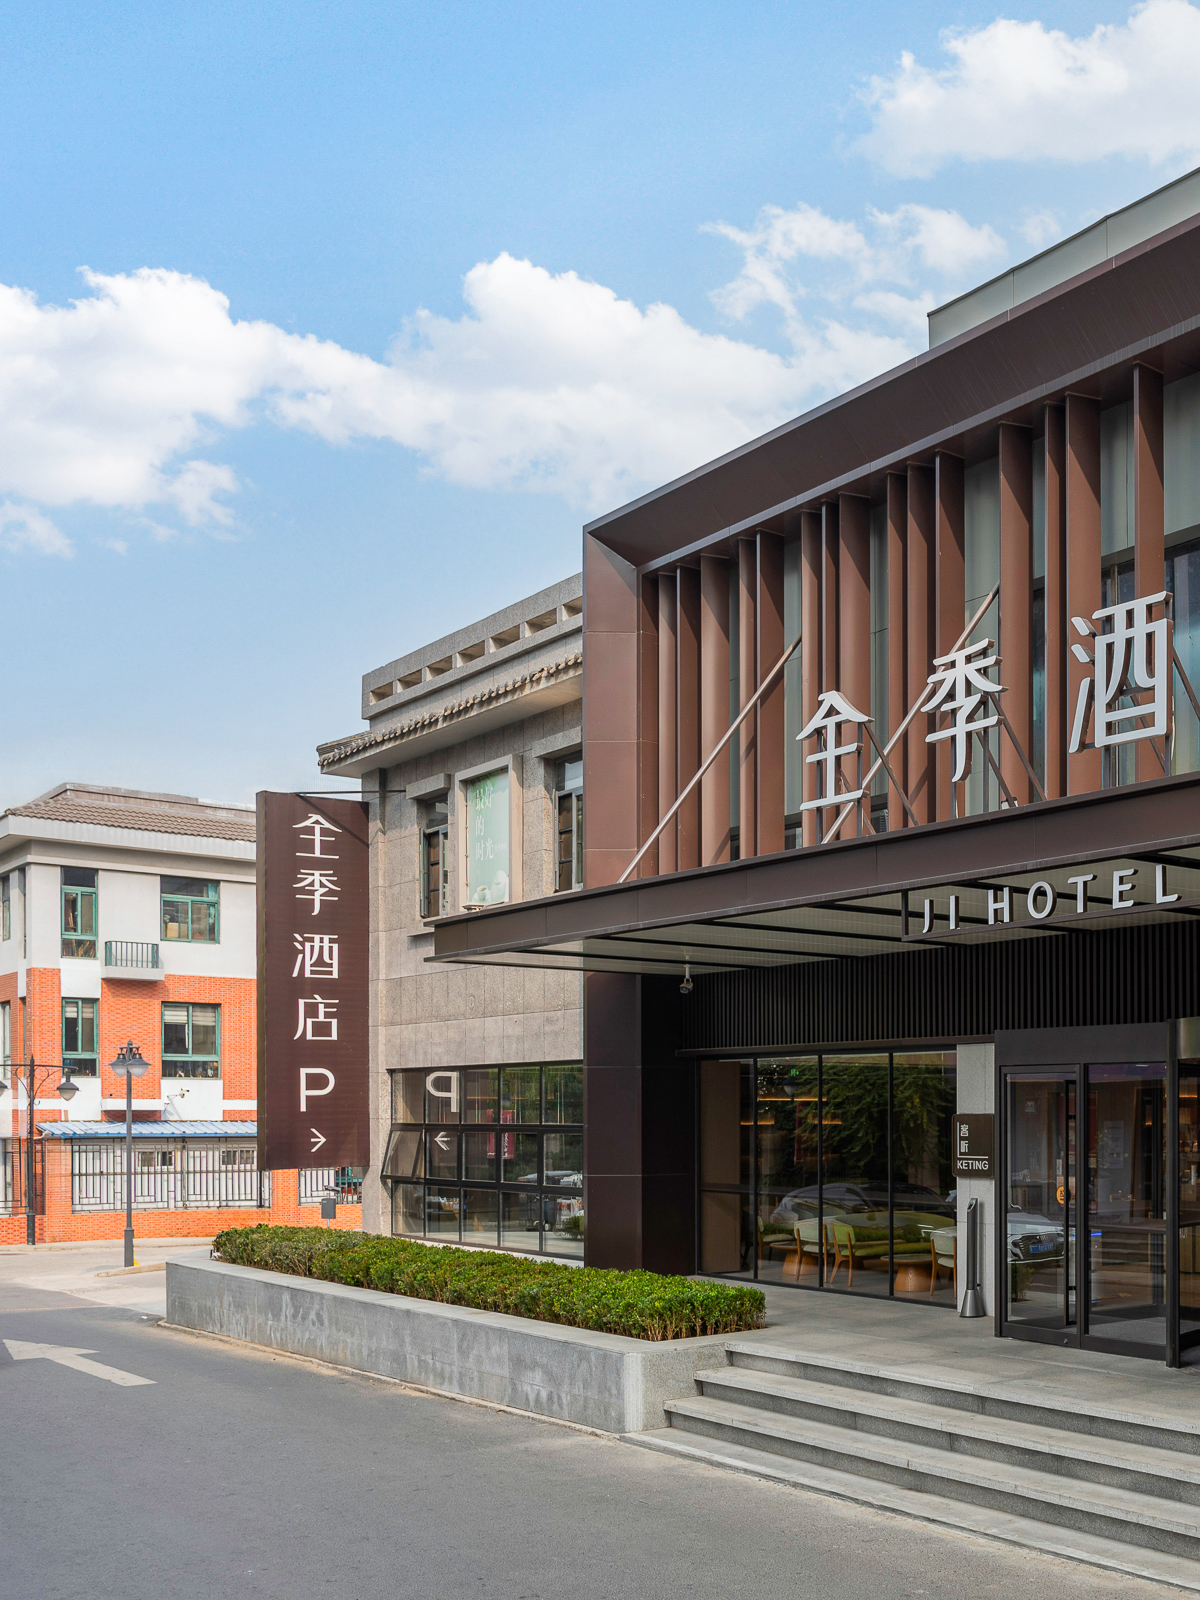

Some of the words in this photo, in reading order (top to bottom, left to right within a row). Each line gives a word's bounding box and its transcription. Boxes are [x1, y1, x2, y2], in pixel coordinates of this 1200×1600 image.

[475, 786, 494, 809] 最好
[475, 815, 485, 836] 的
[475, 838, 494, 861] 时光
[922, 895, 960, 934] JI
[988, 863, 1181, 924] HOTEL
[292, 814, 342, 1040] 全季酒店
[300, 1068, 335, 1112] P
[957, 1160, 989, 1171] KETING
